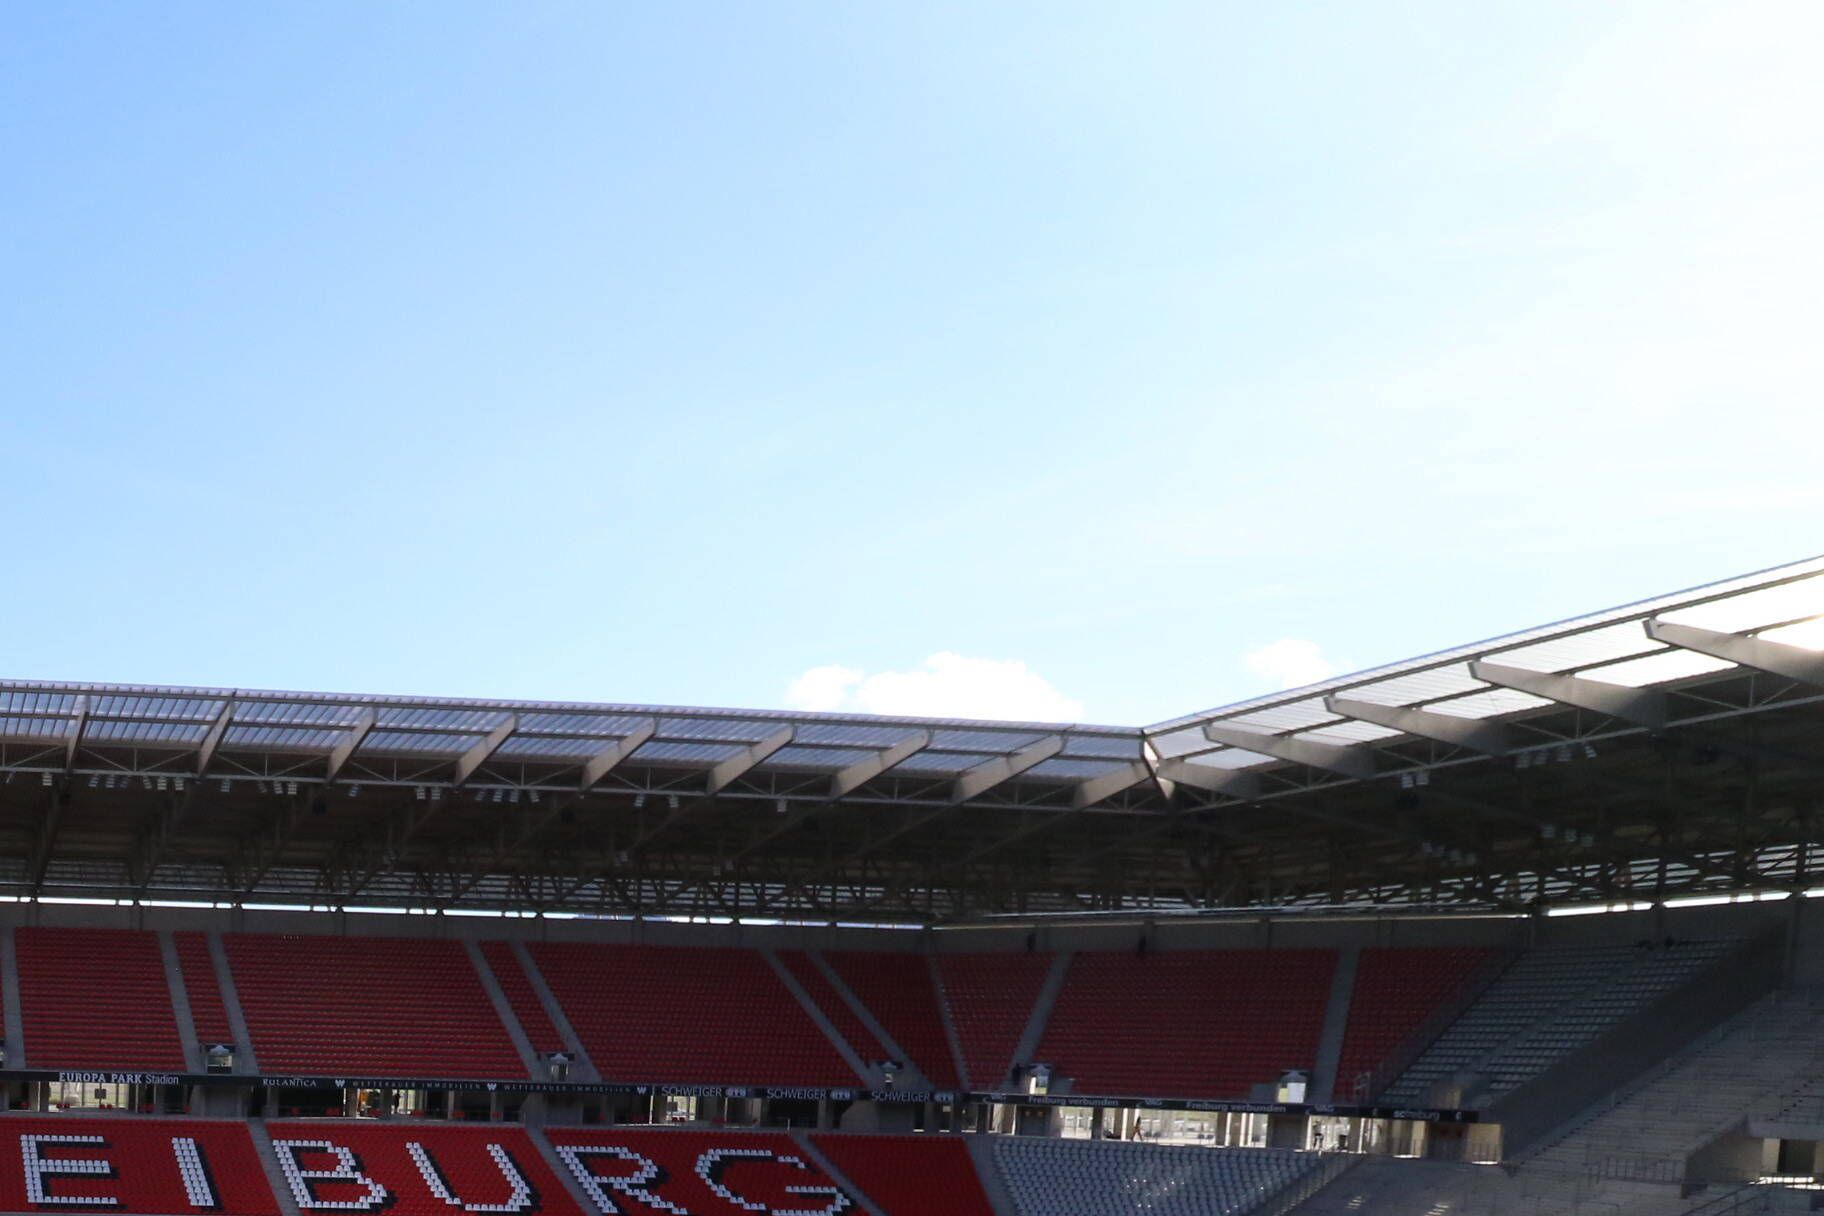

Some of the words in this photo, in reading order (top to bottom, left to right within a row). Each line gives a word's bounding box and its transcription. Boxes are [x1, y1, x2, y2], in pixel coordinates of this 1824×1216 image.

[59, 1072, 106, 1082] EUROPA
[111, 1073, 142, 1084] PARK
[145, 1074, 179, 1085] Stadion
[661, 1087, 722, 1097] SCHWEIGER
[767, 1088, 826, 1100] SCHWEIGER
[871, 1090, 930, 1102] SCHWEIGER
[1028, 1095, 1066, 1107] Freiburg
[1068, 1096, 1119, 1106] verbunden
[1185, 1101, 1229, 1113] Freiburg
[1231, 1102, 1287, 1113] verbunden
